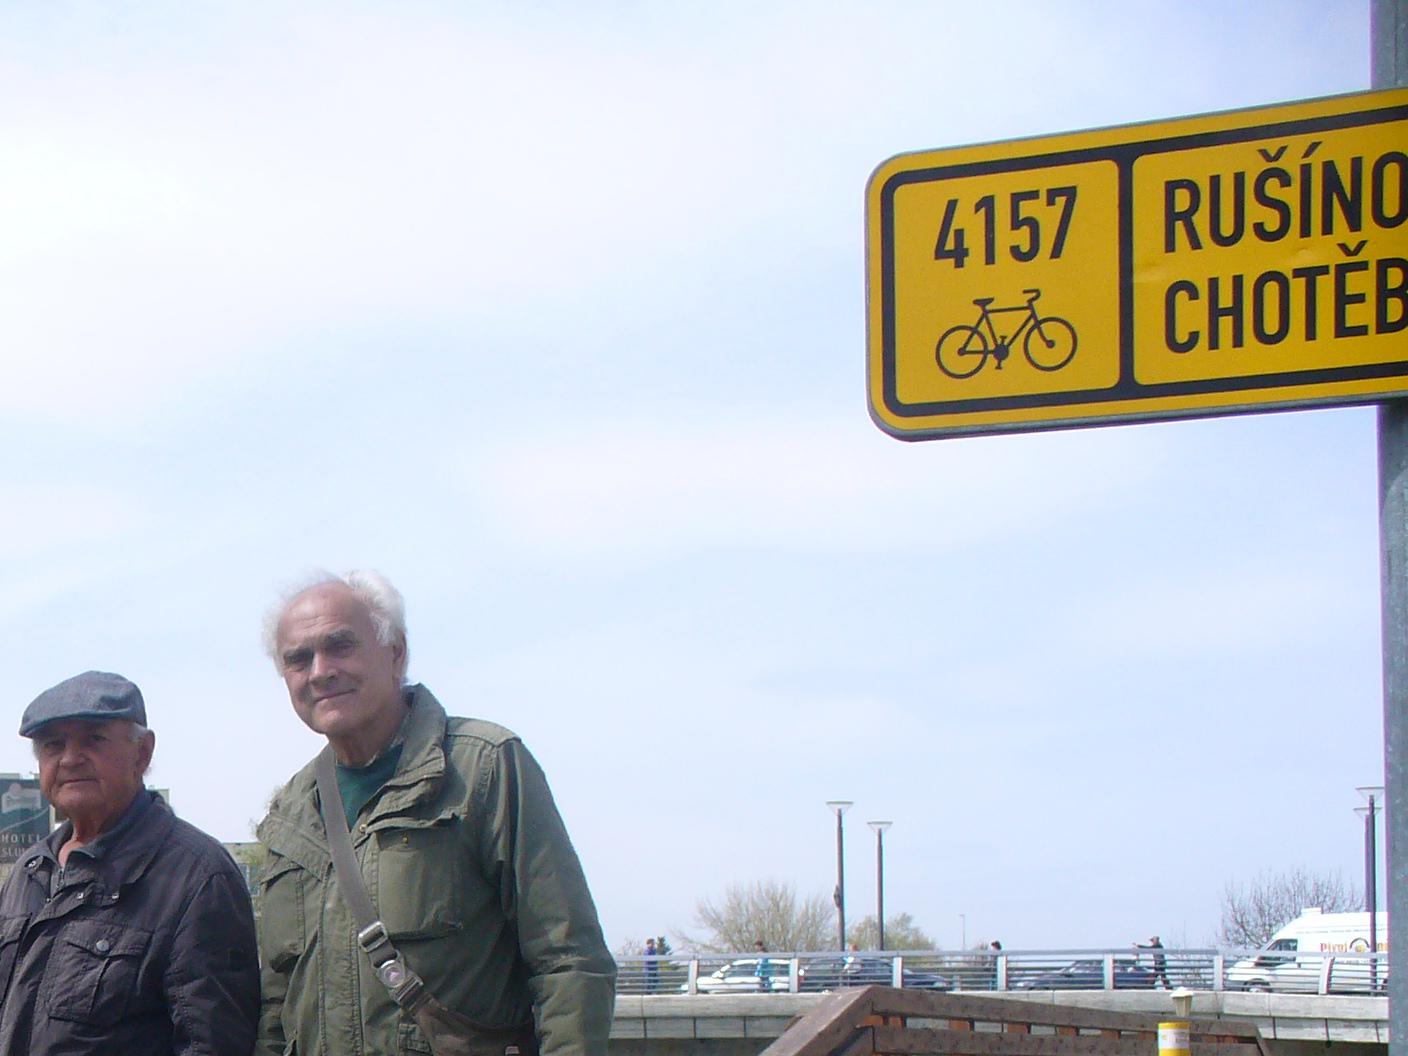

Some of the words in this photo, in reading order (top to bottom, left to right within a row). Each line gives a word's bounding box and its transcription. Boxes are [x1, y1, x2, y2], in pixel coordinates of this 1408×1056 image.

[934, 185, 1078, 269] 4157
[1164, 140, 1408, 253] RUŠÍNO
[1164, 239, 1408, 354] CHOTĚB
[1, 833, 41, 844] HOTEL
